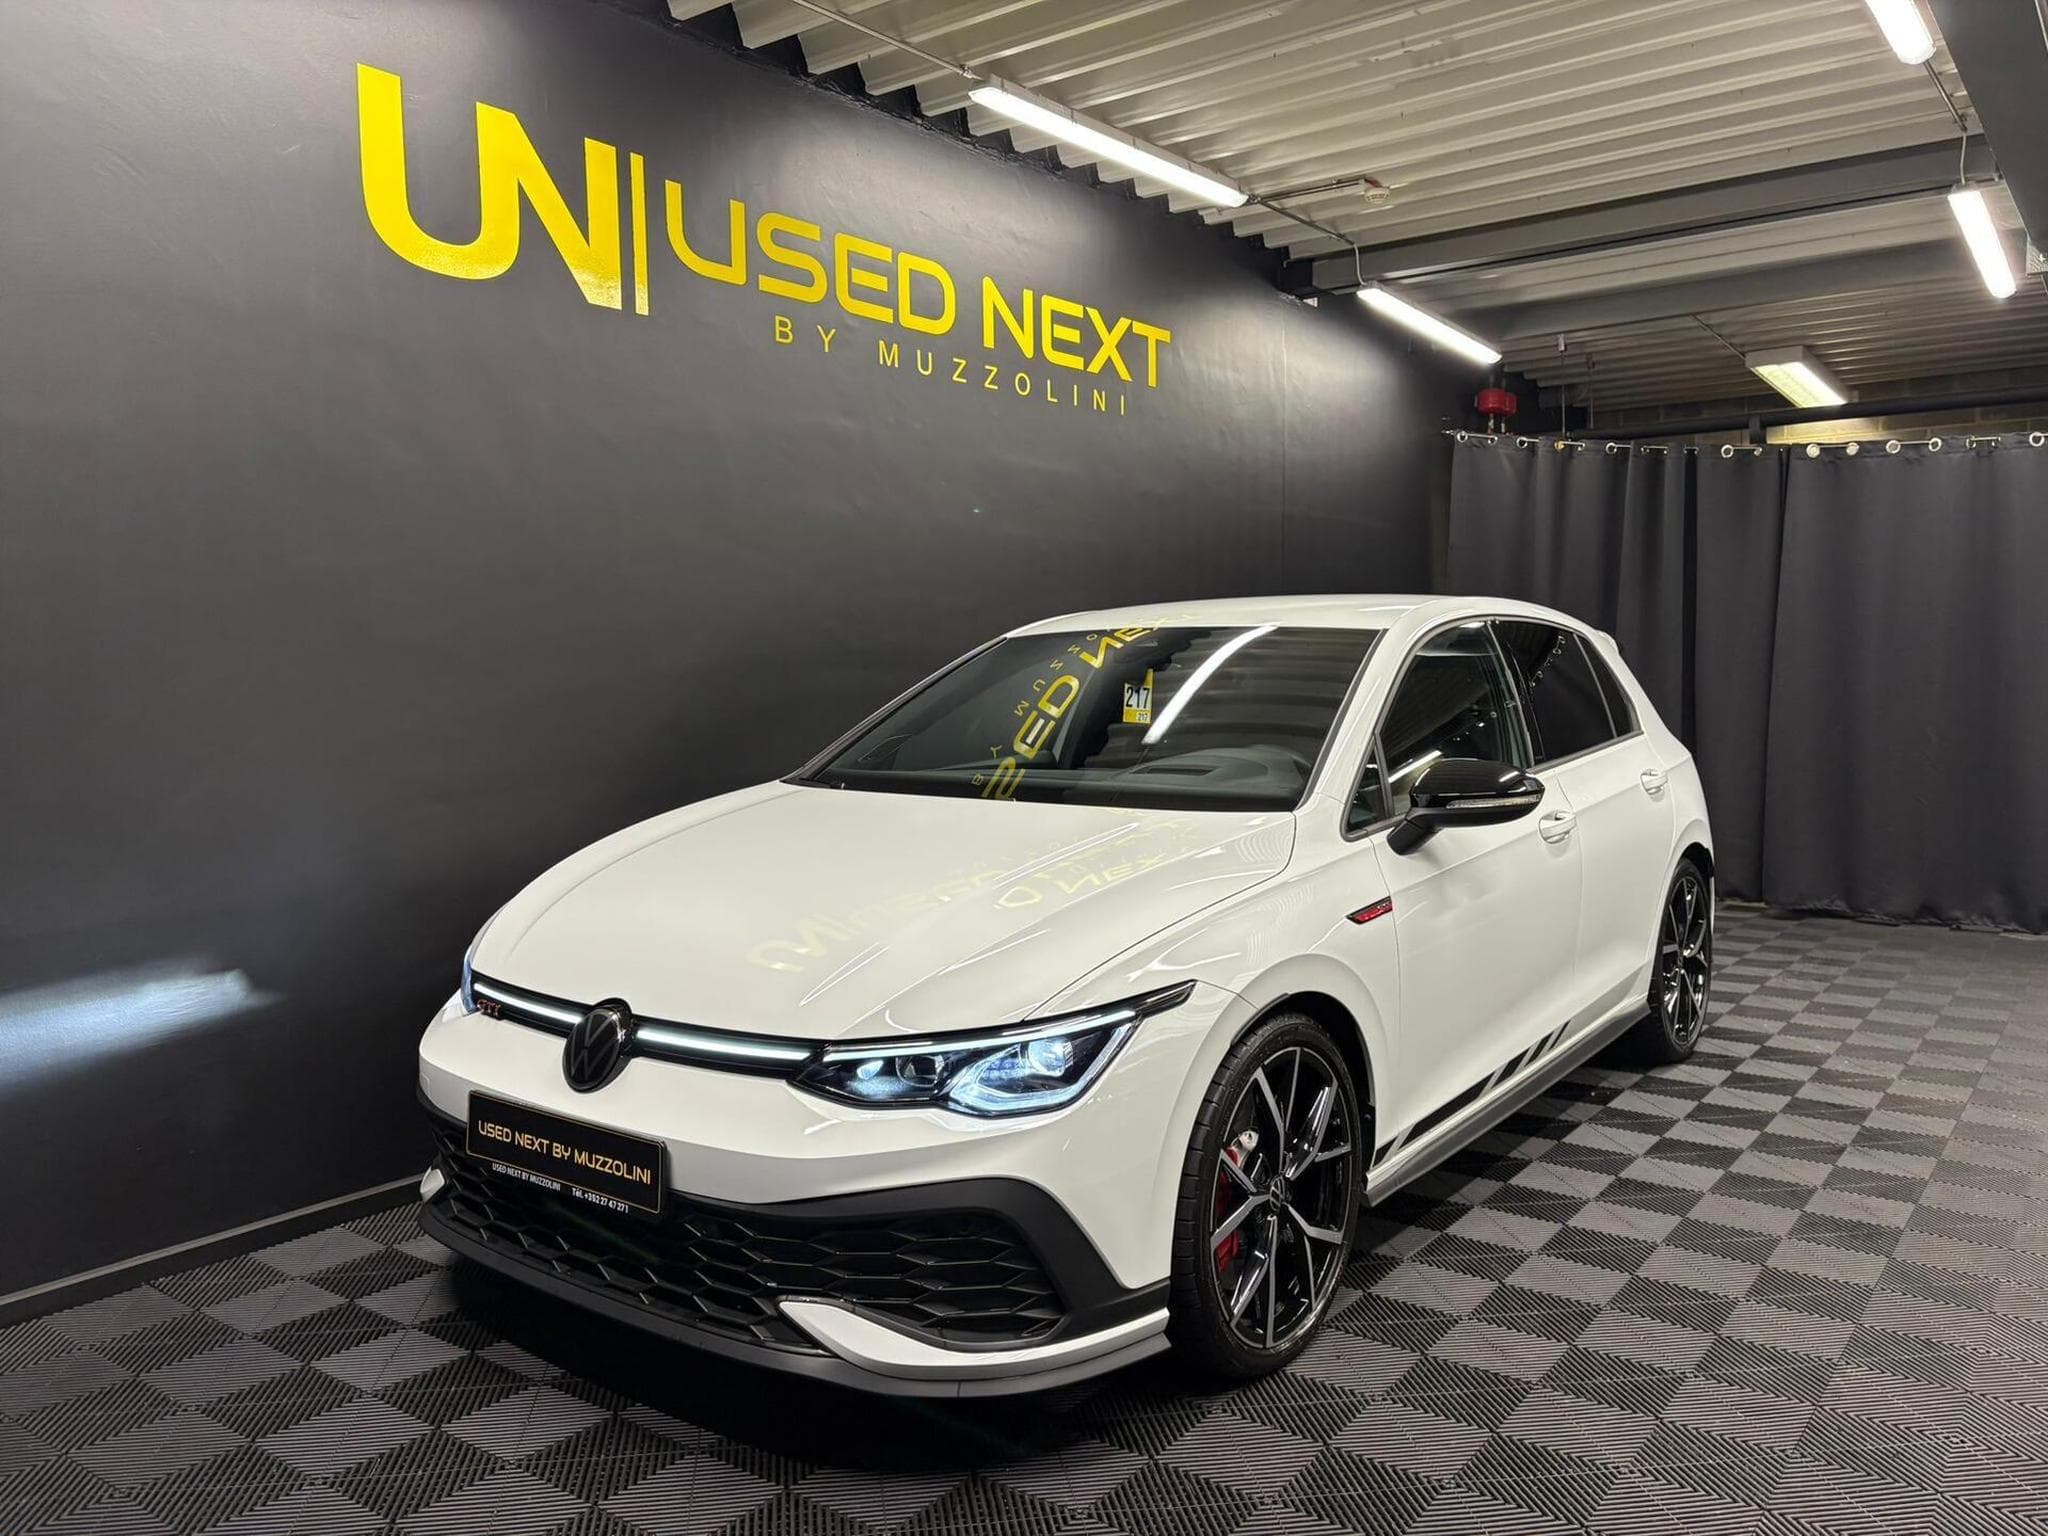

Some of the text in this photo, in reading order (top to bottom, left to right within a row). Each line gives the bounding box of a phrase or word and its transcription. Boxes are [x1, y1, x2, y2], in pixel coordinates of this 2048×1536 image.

[665, 179, 1171, 389] USED NEXT
[775, 315, 1125, 416] BY MUZZOLINI
[1125, 686, 1151, 709] 217
[478, 1119, 651, 1185] USED NEXT BY MUZZOLINI
[492, 1162, 561, 1192] USED NEXT BY MUZZOLINI
